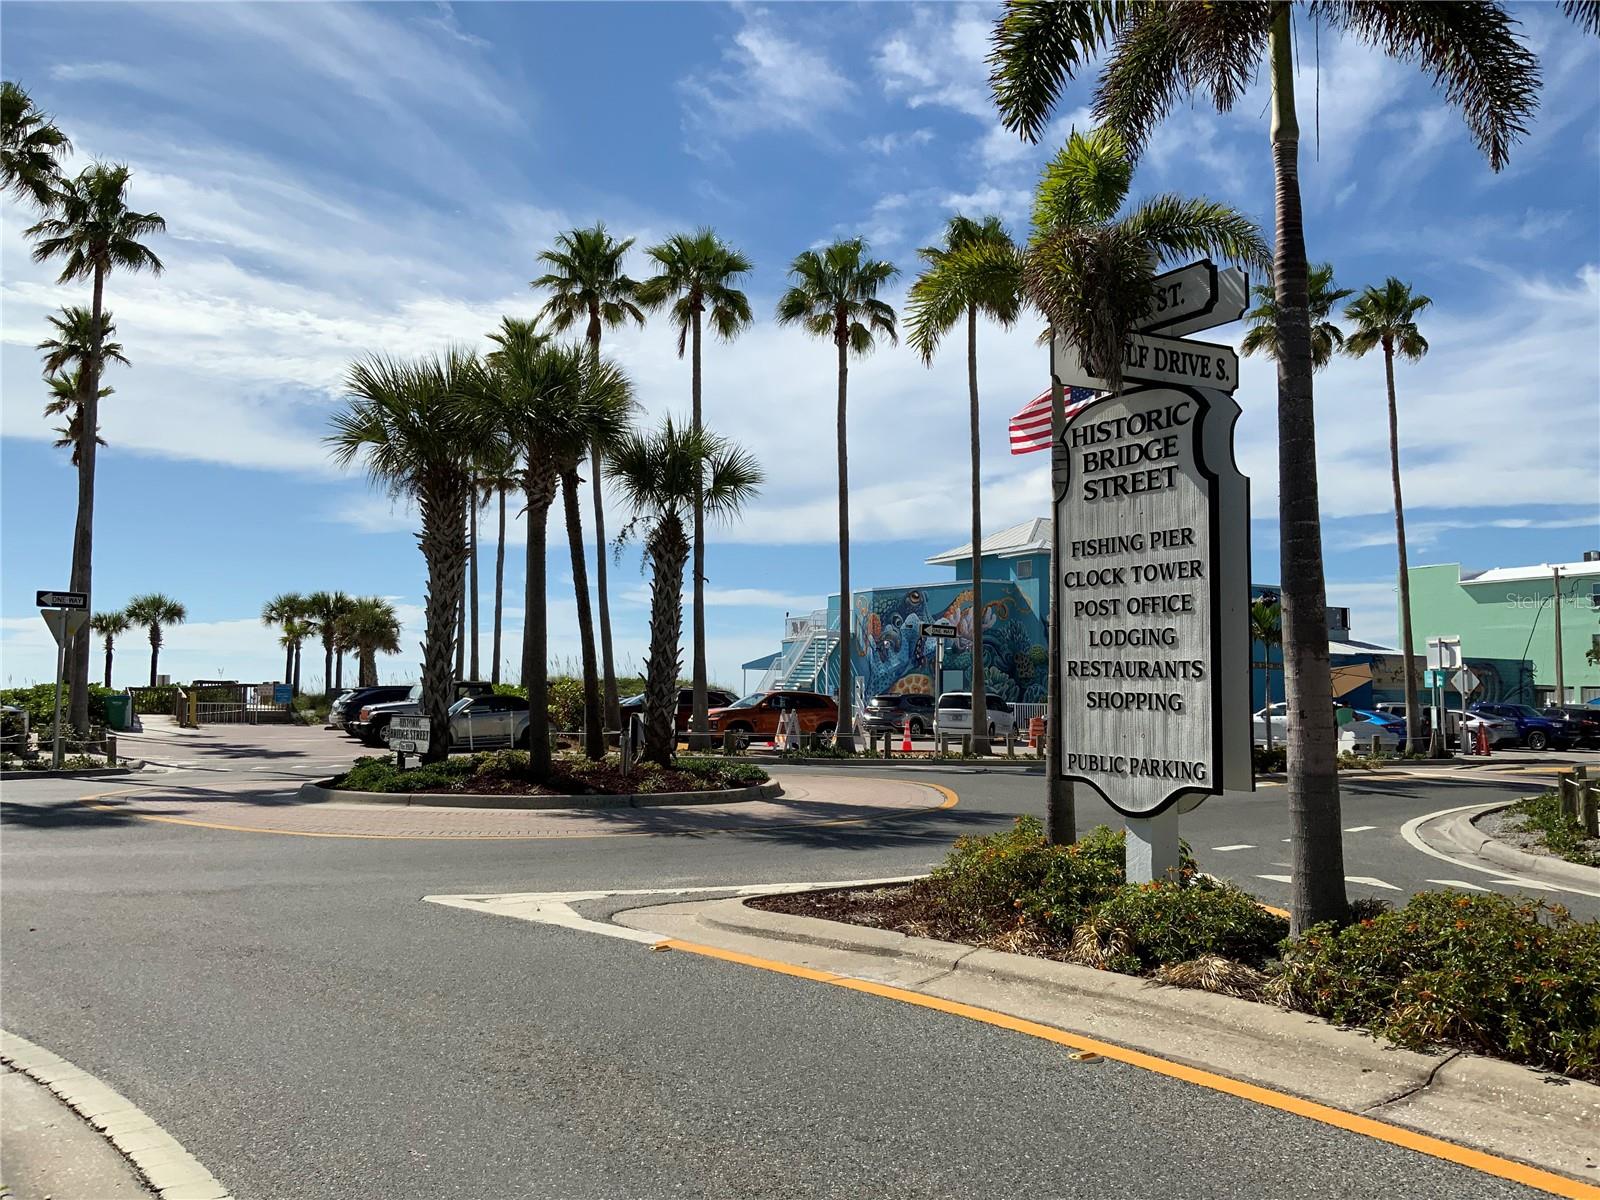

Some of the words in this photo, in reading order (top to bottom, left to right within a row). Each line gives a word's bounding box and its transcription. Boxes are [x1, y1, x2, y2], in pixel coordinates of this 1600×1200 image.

[1157, 282, 1185, 312] ST.
[1153, 347, 1211, 378] DRIVE
[1216, 358, 1230, 382] S.
[1071, 402, 1191, 448] HISTORIC
[1083, 435, 1179, 473] BRIDGE
[1084, 465, 1179, 501] STREET
[1071, 533, 1144, 558] FISHING
[1150, 527, 1194, 549] PIER
[1064, 567, 1125, 589] CLOCK
[1131, 560, 1204, 583] TOWER
[52, 596, 65, 604] ONE
[68, 597, 82, 605] WAY
[1074, 598, 1120, 617] POST
[1127, 594, 1192, 615] OFFICE
[1089, 628, 1176, 647] LODGING
[1067, 660, 1203, 678] RESTAURANTS
[1087, 691, 1183, 711] SHOPPING
[410, 729, 429, 741] STREET
[1067, 753, 1126, 774] PUBLIC
[1130, 757, 1206, 780] PARKING
